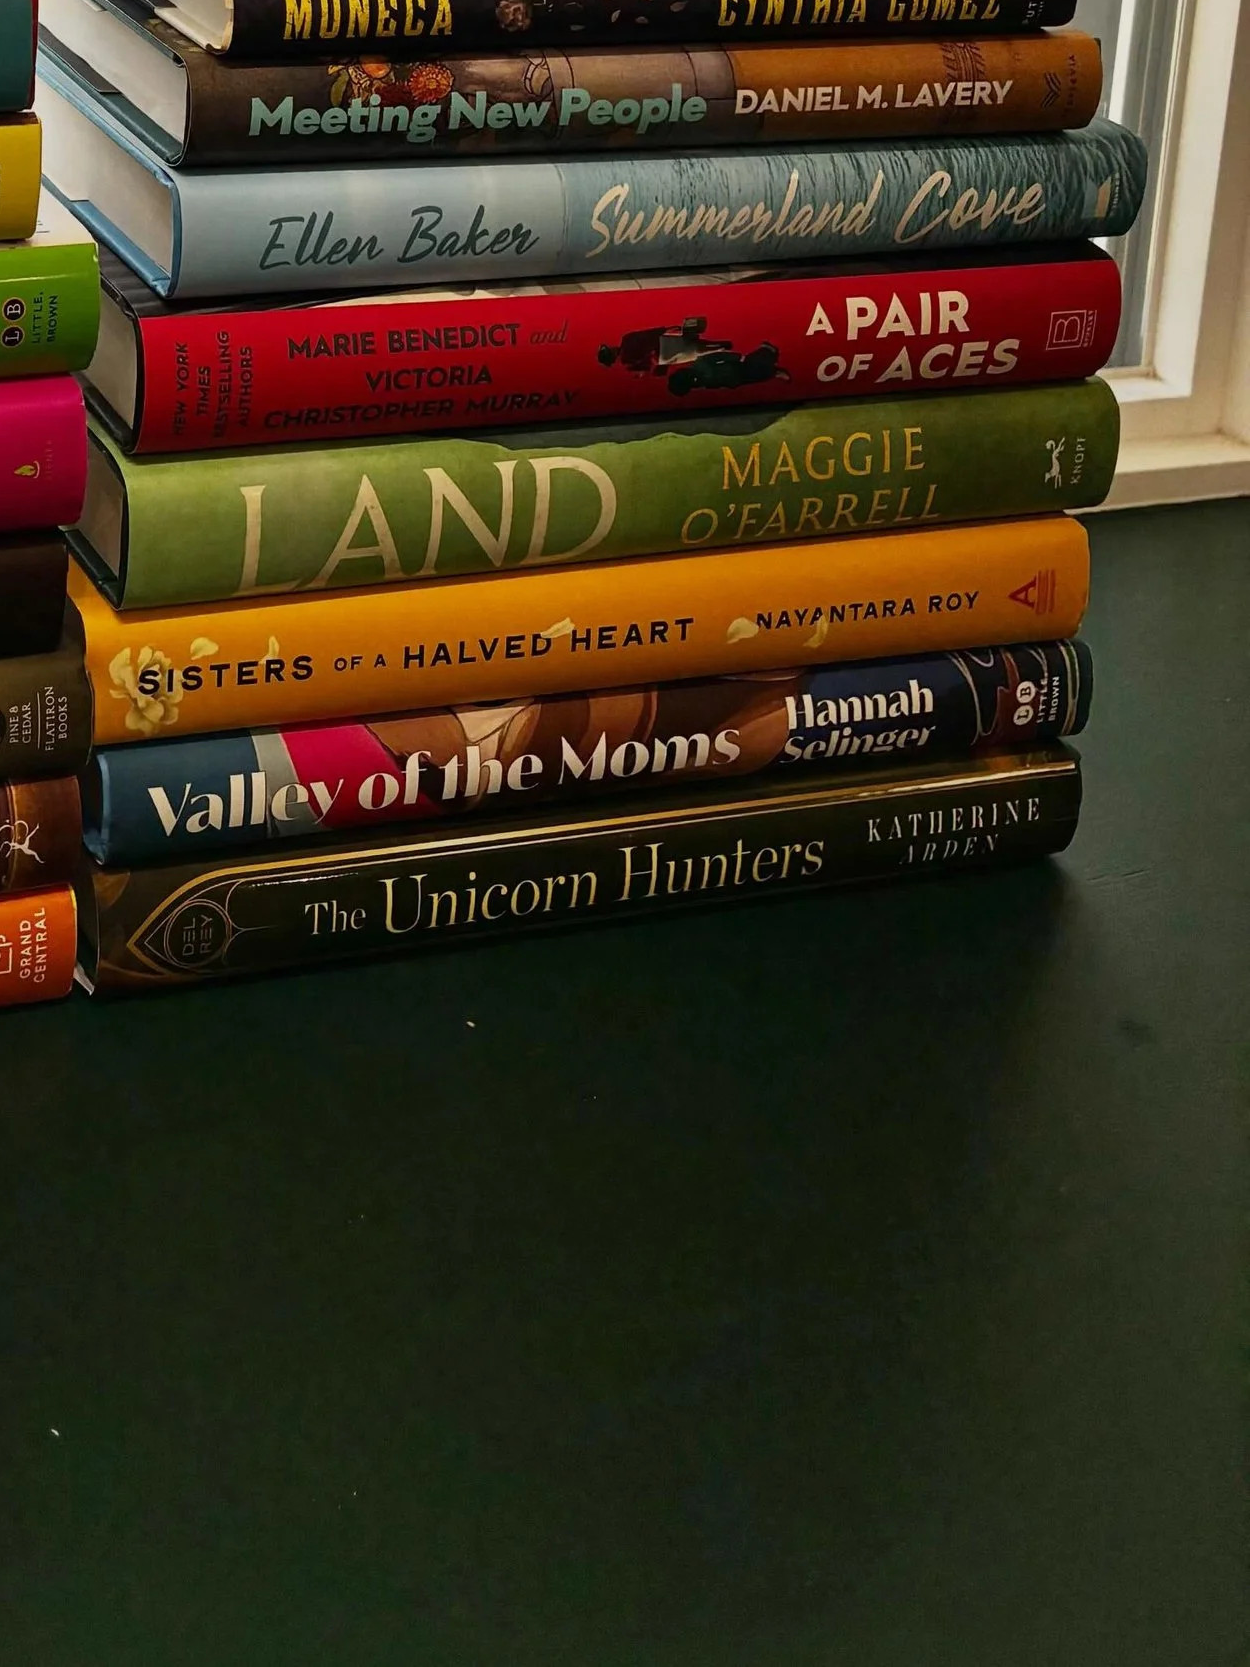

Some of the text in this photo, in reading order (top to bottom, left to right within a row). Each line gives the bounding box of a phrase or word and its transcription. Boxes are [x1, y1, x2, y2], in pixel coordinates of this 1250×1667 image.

[250, 83, 708, 143] Meeting New People
[735, 80, 1014, 115] DANIEL M. LAVERY
[258, 204, 540, 272] Ellen Baker
[586, 168, 885, 259] Summerland
[894, 169, 1046, 246] Cove
[47, 295, 58, 343] BROWN
[286, 320, 570, 360] MARIE BENEDICT and
[805, 290, 971, 341] A PAIR
[175, 342, 188, 391] YORK
[237, 344, 254, 427] AUTHORS
[365, 365, 494, 393] VICTORIA
[817, 339, 1021, 383] OF ACES
[196, 365, 211, 417] TIMES
[262, 389, 581, 430] CHRISTOPHER MURRAY
[721, 427, 926, 491] MAGGIE
[1070, 436, 1087, 486] KNOPF
[236, 455, 618, 597] LAND
[756, 591, 979, 630] NAYANTARA ROY
[138, 617, 695, 696] SISTERS OF A HALVED HEART
[22, 702, 32, 744] CEDAR
[44, 686, 55, 751] FLATIRON
[58, 696, 68, 740] BOOKS
[785, 679, 934, 731] Hannah
[1048, 676, 1060, 722] BROWN
[9, 717, 19, 744] PINE
[779, 724, 936, 764] Selinger
[147, 727, 741, 837] Valley of the Moms
[866, 797, 1042, 843] KATHERINE
[899, 833, 1000, 866] ARDEN
[304, 837, 824, 937] The Unicorn Hunters
[19, 920, 32, 979] GRAND
[33, 907, 47, 983] CENTRAL
[182, 917, 195, 956] DEL
[199, 914, 213, 954] REY
